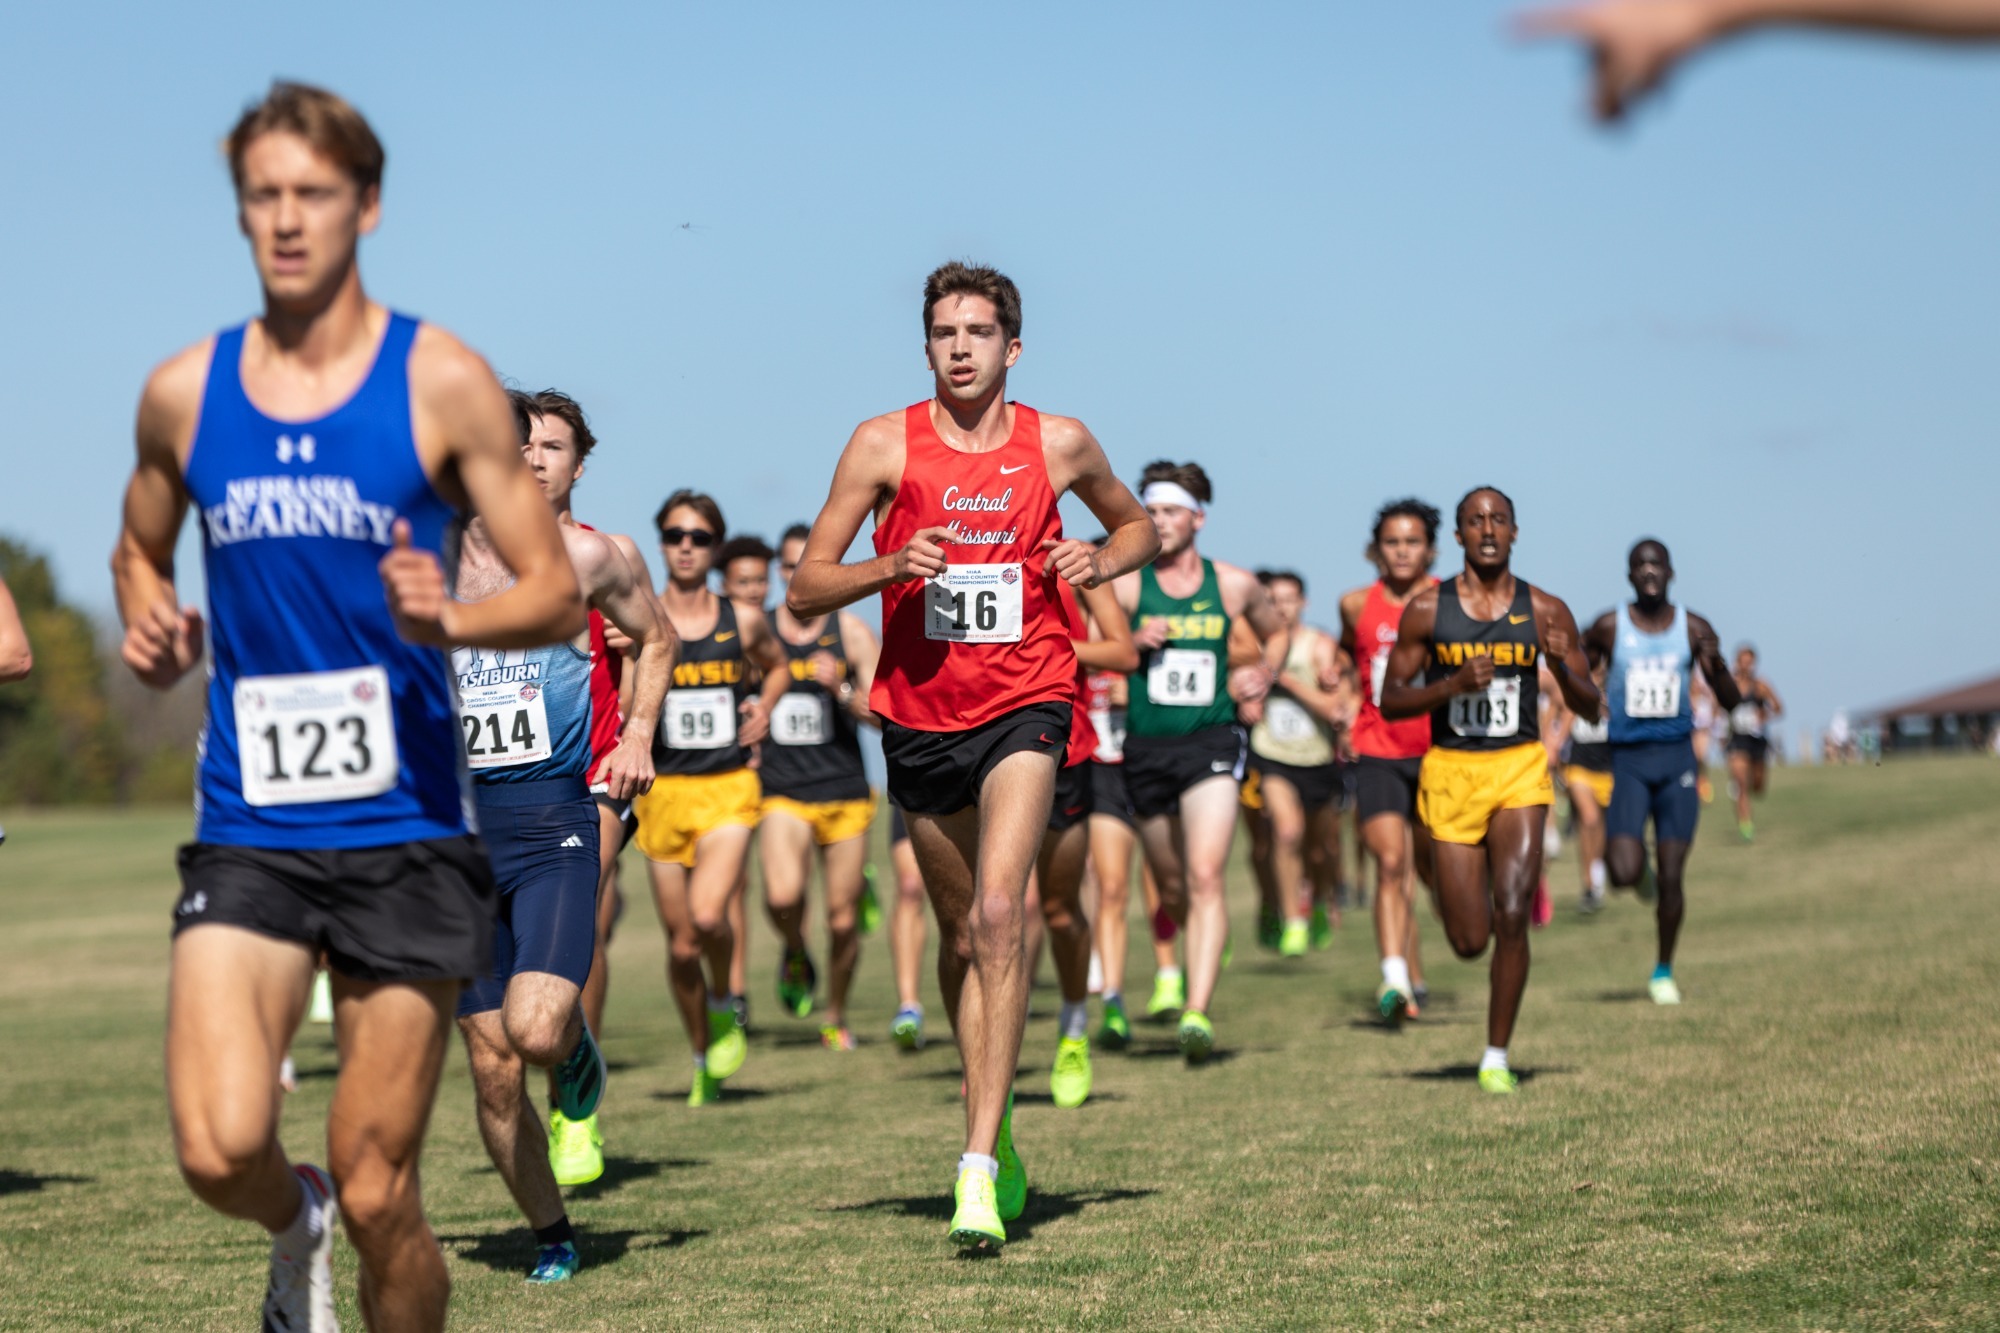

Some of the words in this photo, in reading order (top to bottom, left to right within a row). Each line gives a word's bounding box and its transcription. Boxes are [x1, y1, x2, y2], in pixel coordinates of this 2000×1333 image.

[942, 486, 1013, 512] Central
[204, 500, 398, 549] KEARNEY
[952, 590, 997, 631] 16
[457, 661, 541, 690] ASHBURN
[1167, 671, 1197, 697] 84
[468, 699, 517, 709] CHAMPIONSHIPS
[487, 694, 516, 702] COUNTRY
[680, 711, 714, 740] 99
[1460, 698, 1508, 728] 103
[462, 708, 536, 756] 214
[262, 713, 373, 783] 123
